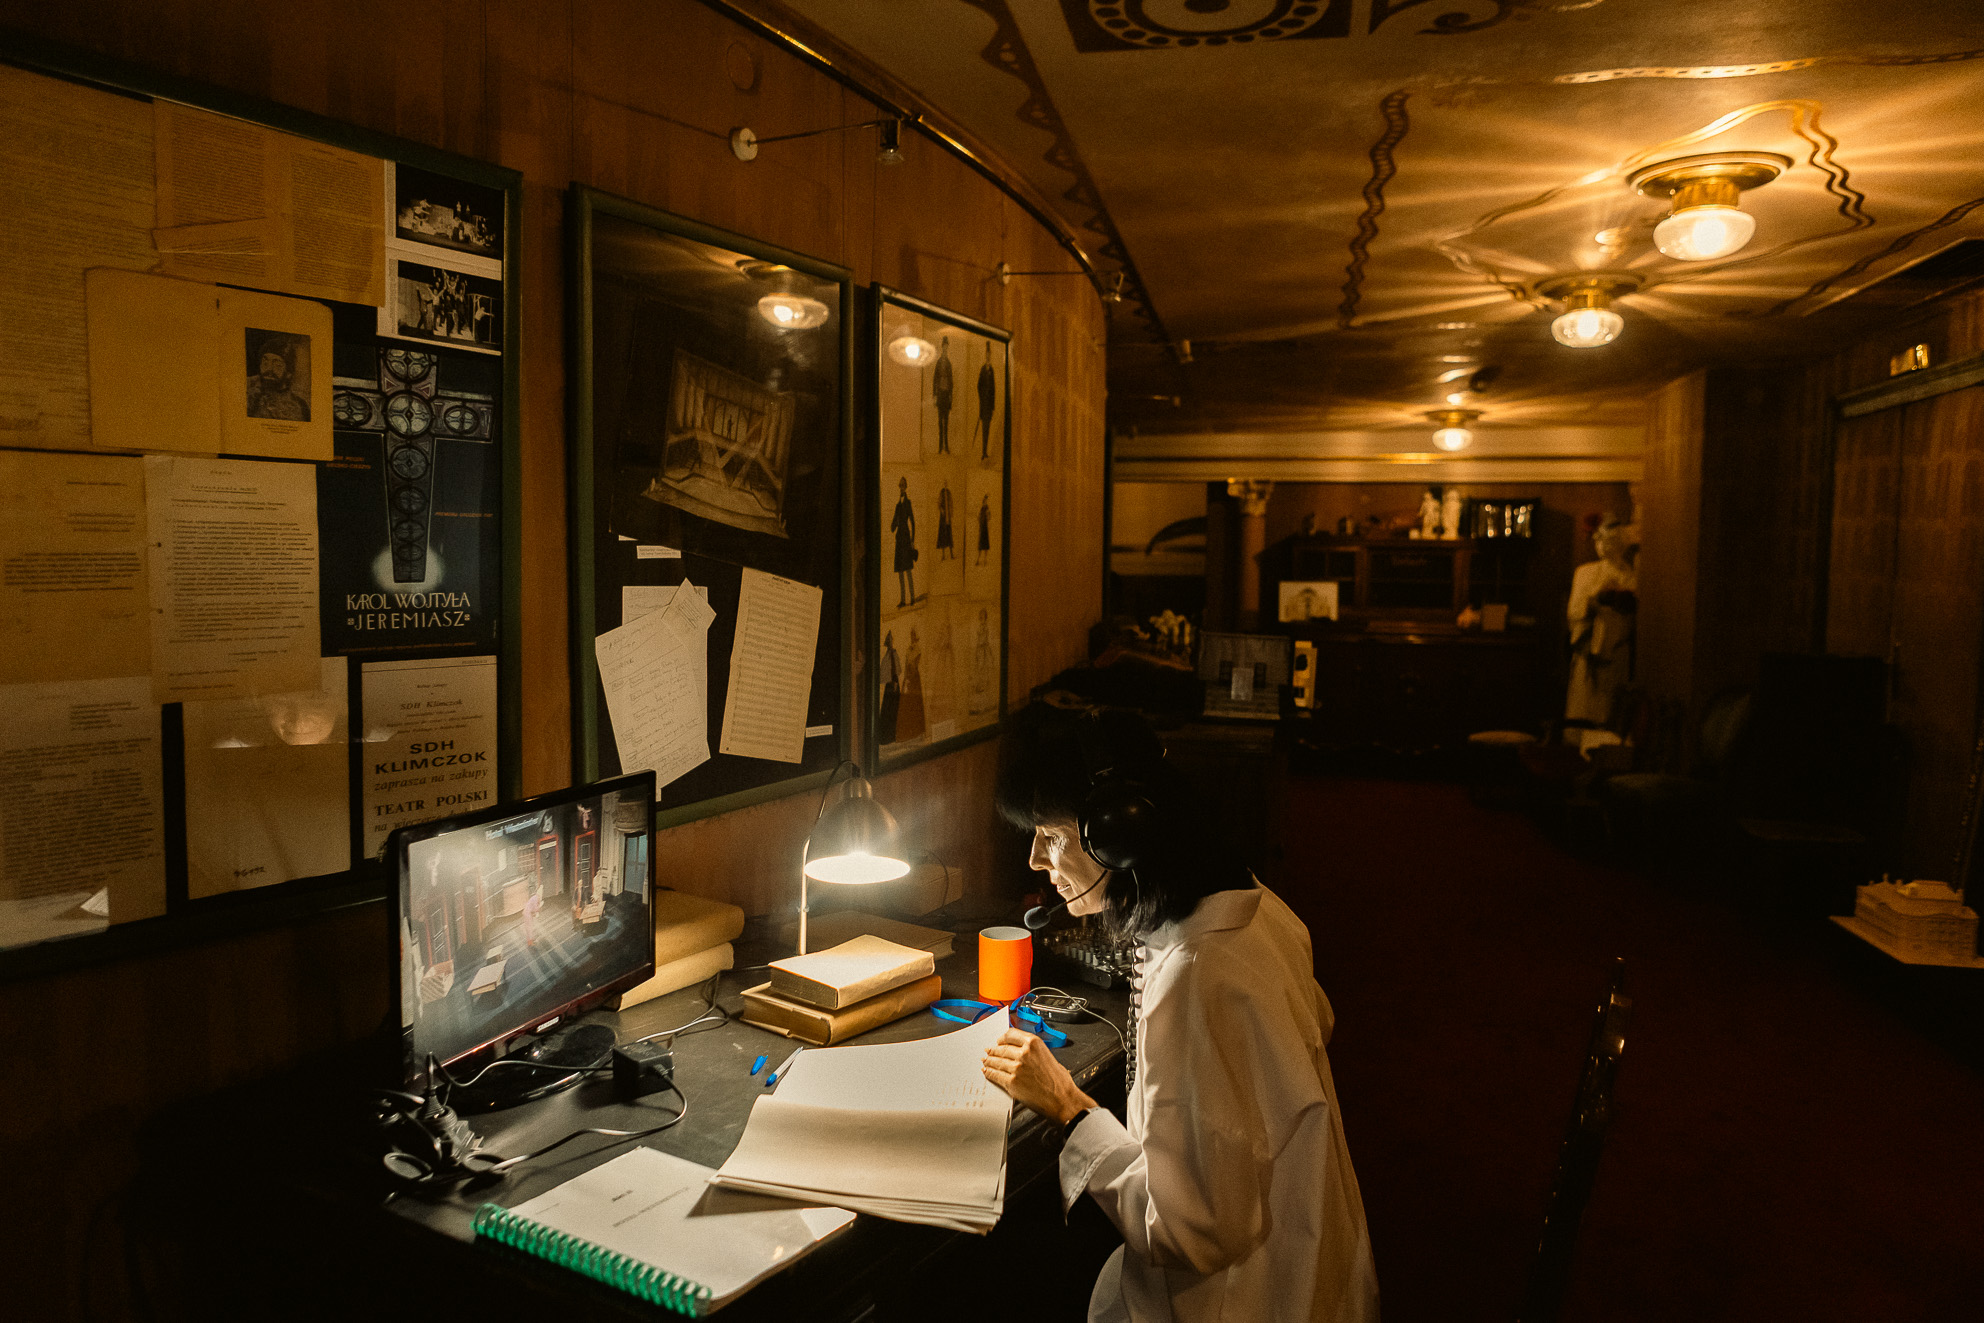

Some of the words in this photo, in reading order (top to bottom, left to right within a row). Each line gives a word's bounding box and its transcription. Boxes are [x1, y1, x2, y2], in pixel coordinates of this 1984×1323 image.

[347, 594, 391, 611] KAROL
[395, 592, 471, 609] WOJTYŁA
[354, 611, 465, 630] JEREMIASZ
[410, 740, 454, 754] SDH
[375, 751, 487, 774] KLIMCZOK
[374, 777, 426, 792] zaprasza
[431, 774, 445, 783] na
[449, 768, 488, 781] zakupy
[375, 800, 425, 816] TEATR
[437, 790, 488, 806] POLSKI
[374, 823, 387, 833] na
